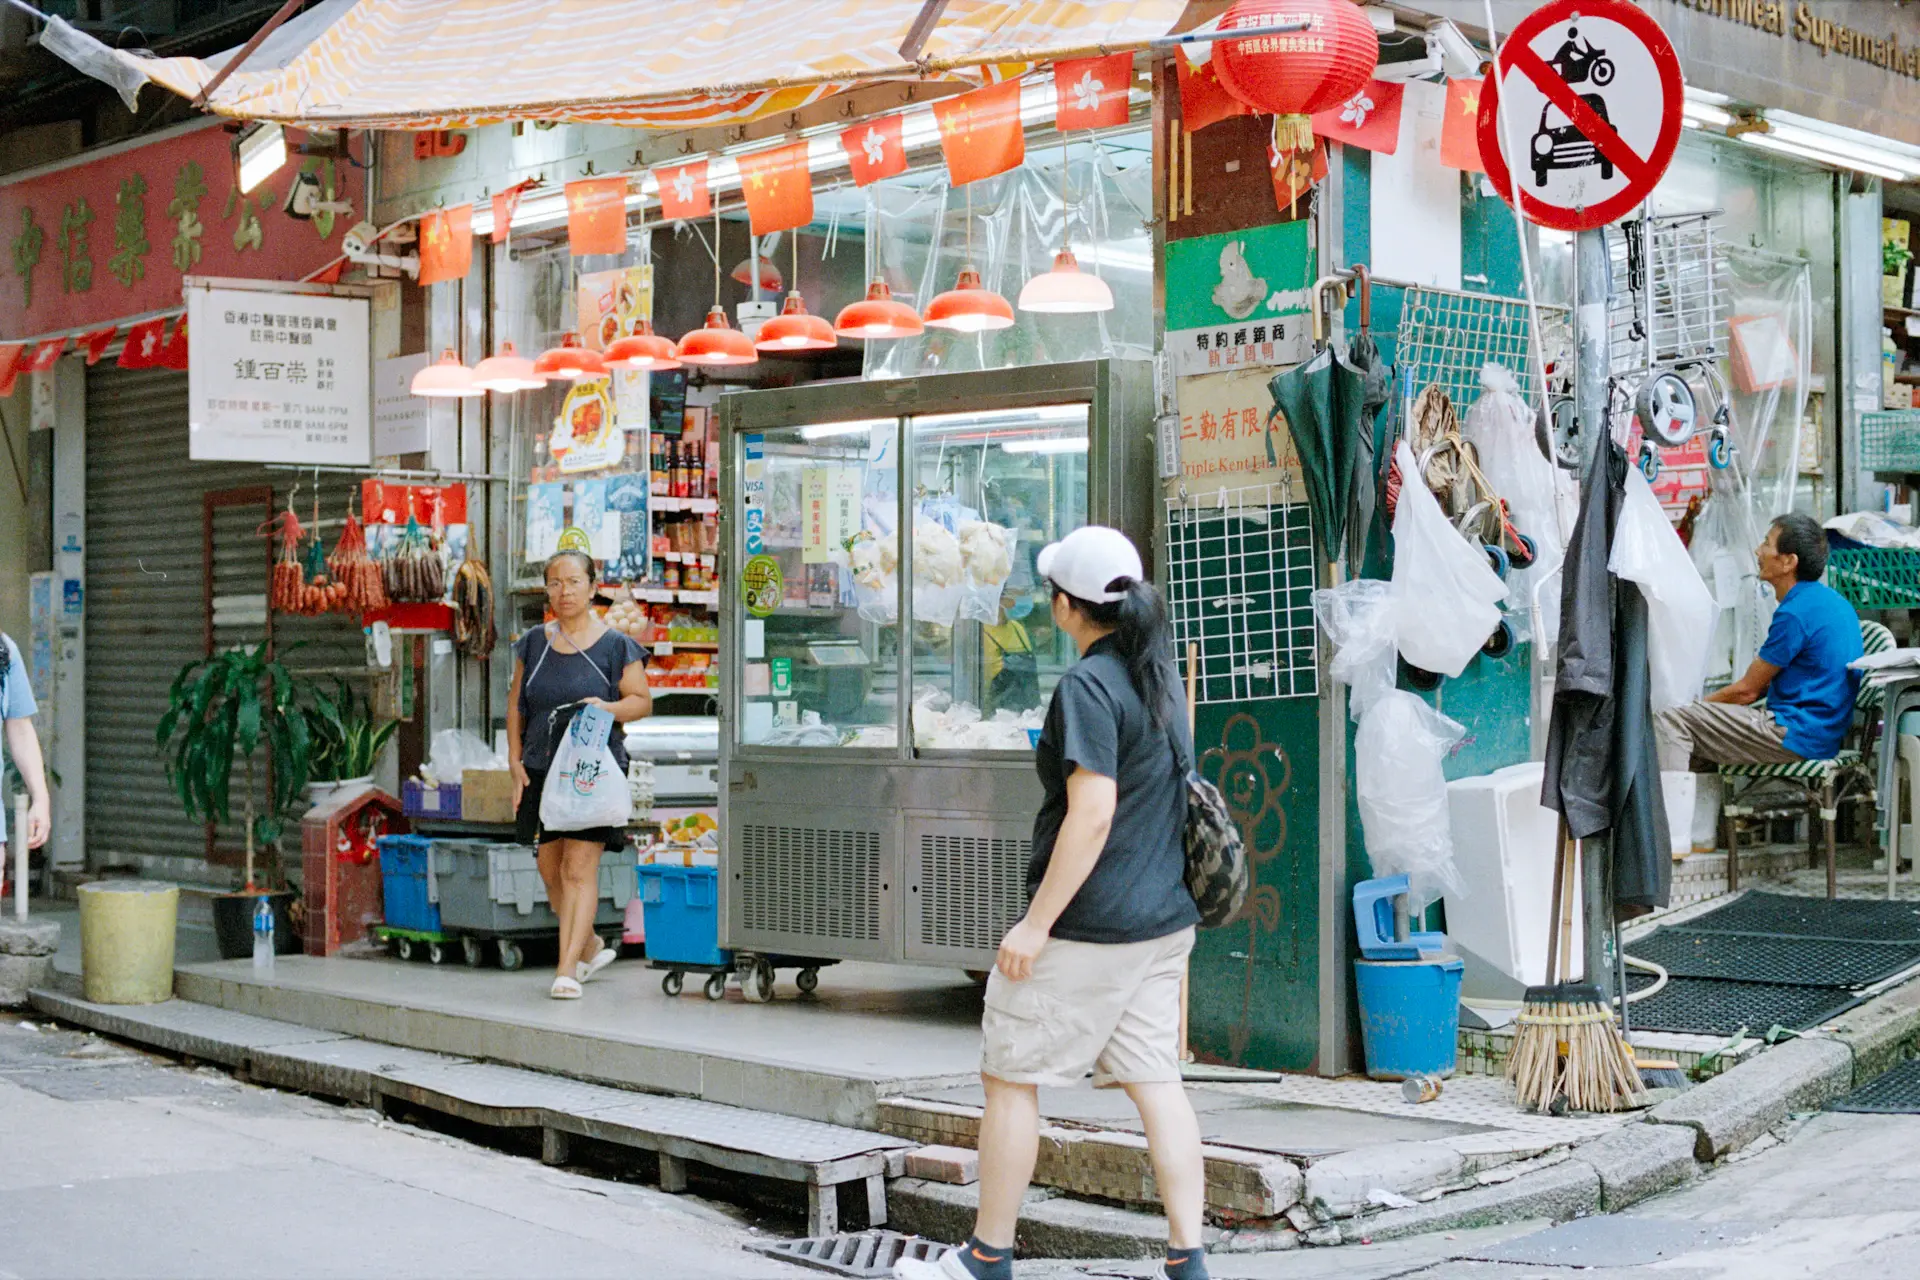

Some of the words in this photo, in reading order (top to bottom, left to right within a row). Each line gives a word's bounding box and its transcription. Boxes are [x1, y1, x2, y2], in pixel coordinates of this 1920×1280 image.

[1196, 324, 1285, 350] 特約經銷商
[1218, 456, 1249, 472] Kent
[744, 481, 764, 492] VISA
